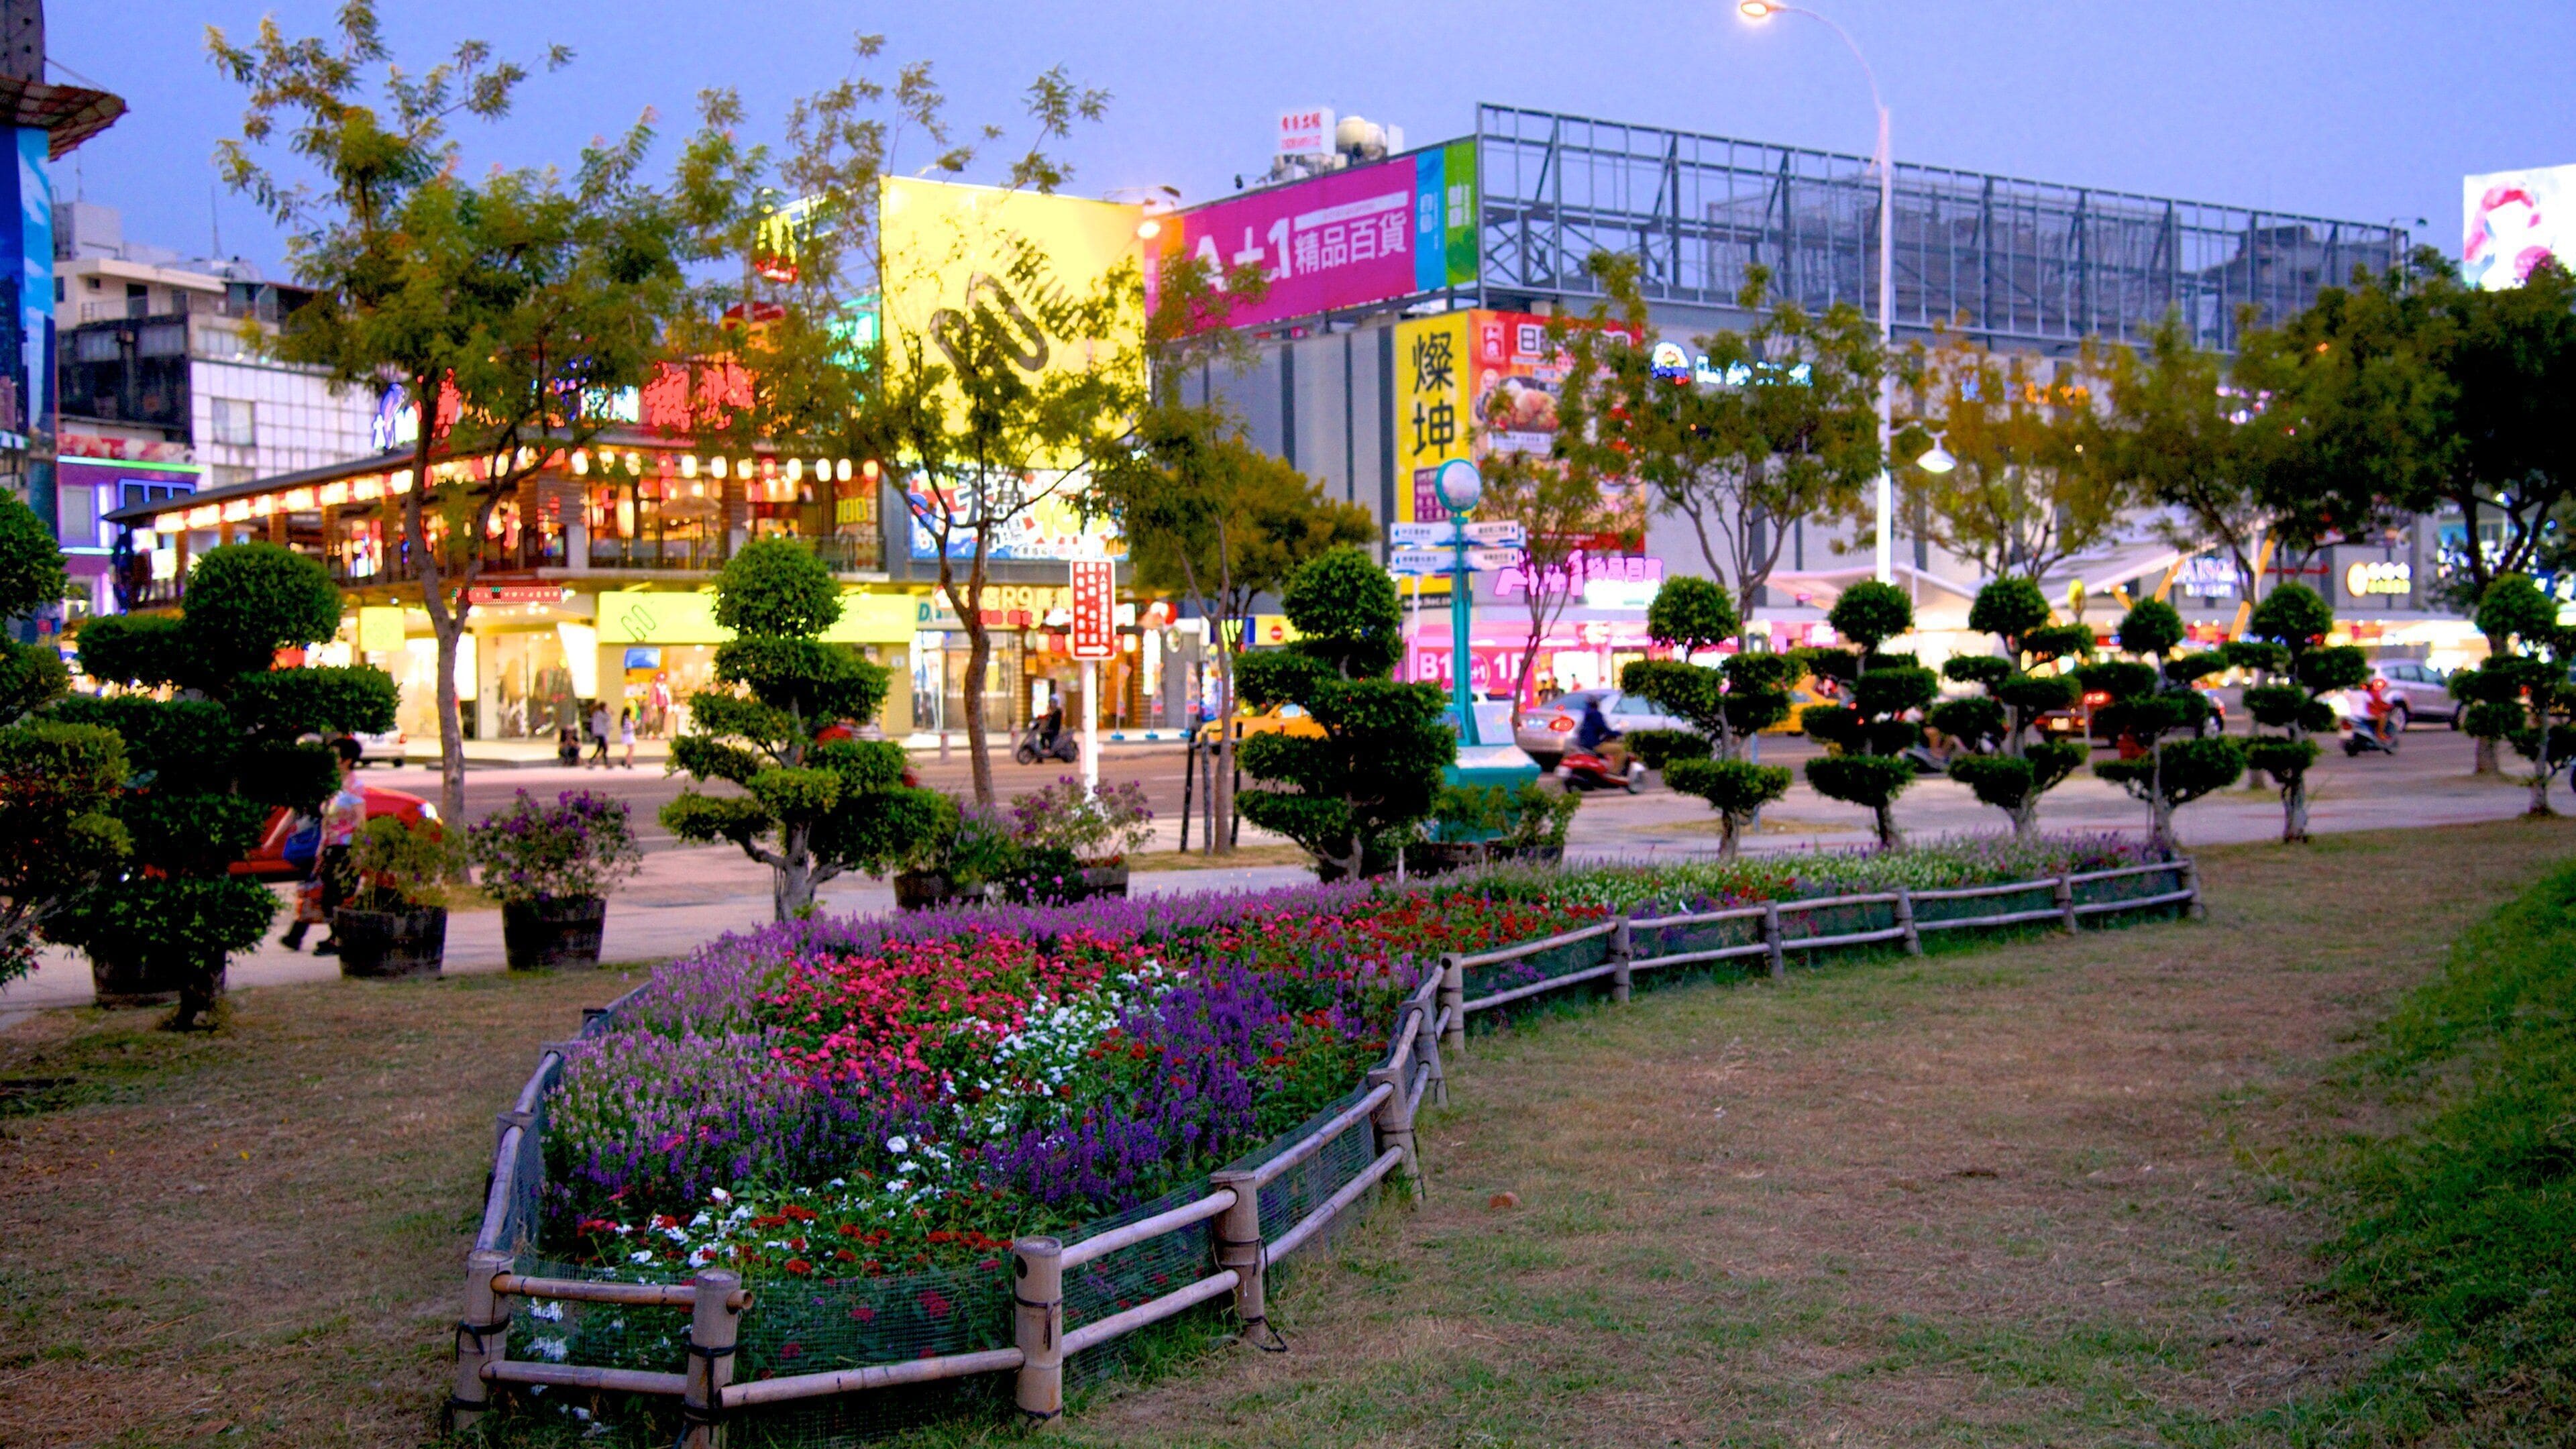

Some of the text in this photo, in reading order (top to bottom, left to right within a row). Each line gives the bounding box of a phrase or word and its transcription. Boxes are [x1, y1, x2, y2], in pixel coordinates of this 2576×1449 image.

[1294, 211, 1407, 276] 精品百貨
[1412, 331, 1455, 459] 燦坤
[1419, 652, 1452, 680] B1
